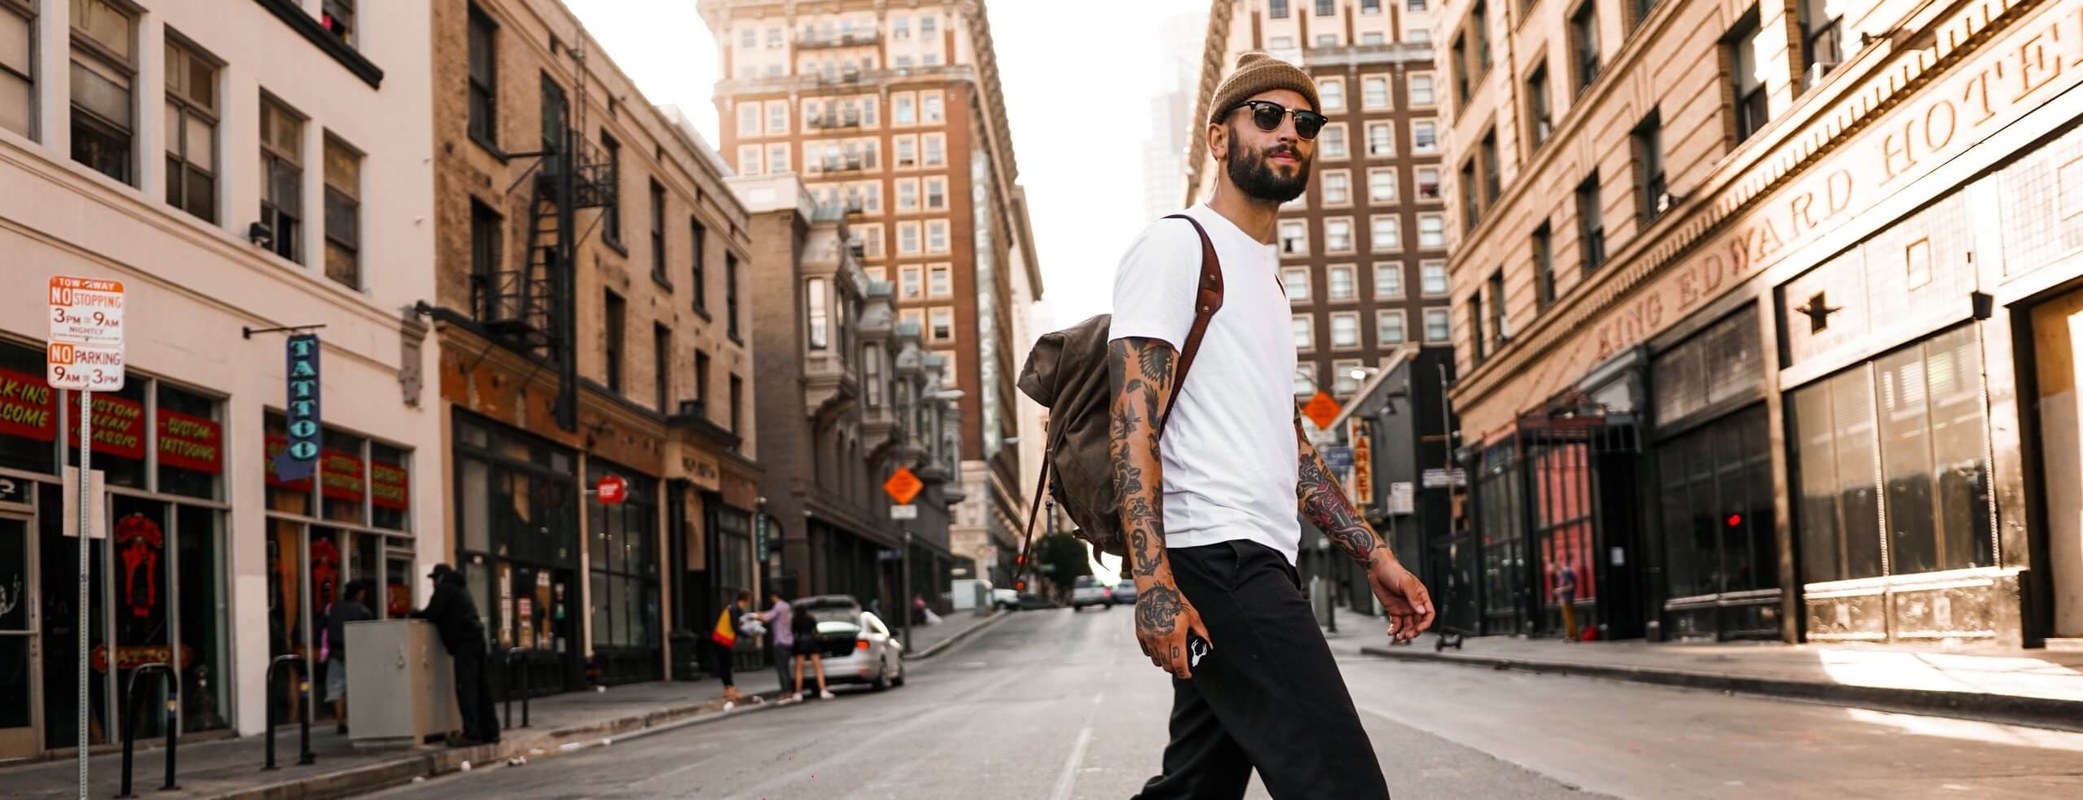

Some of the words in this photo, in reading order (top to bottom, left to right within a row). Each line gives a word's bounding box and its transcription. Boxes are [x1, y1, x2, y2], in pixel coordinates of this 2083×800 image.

[1598, 290, 1664, 362] KING
[1674, 168, 1852, 313] EDWARD
[51, 287, 72, 305] NO
[74, 293, 121, 308] STOPPING
[69, 326, 104, 336] NIGHTLY
[51, 344, 72, 363] NO
[75, 350, 120, 366] PARKING
[290, 339, 318, 459] TATTOO
[91, 414, 132, 432] LEAN
